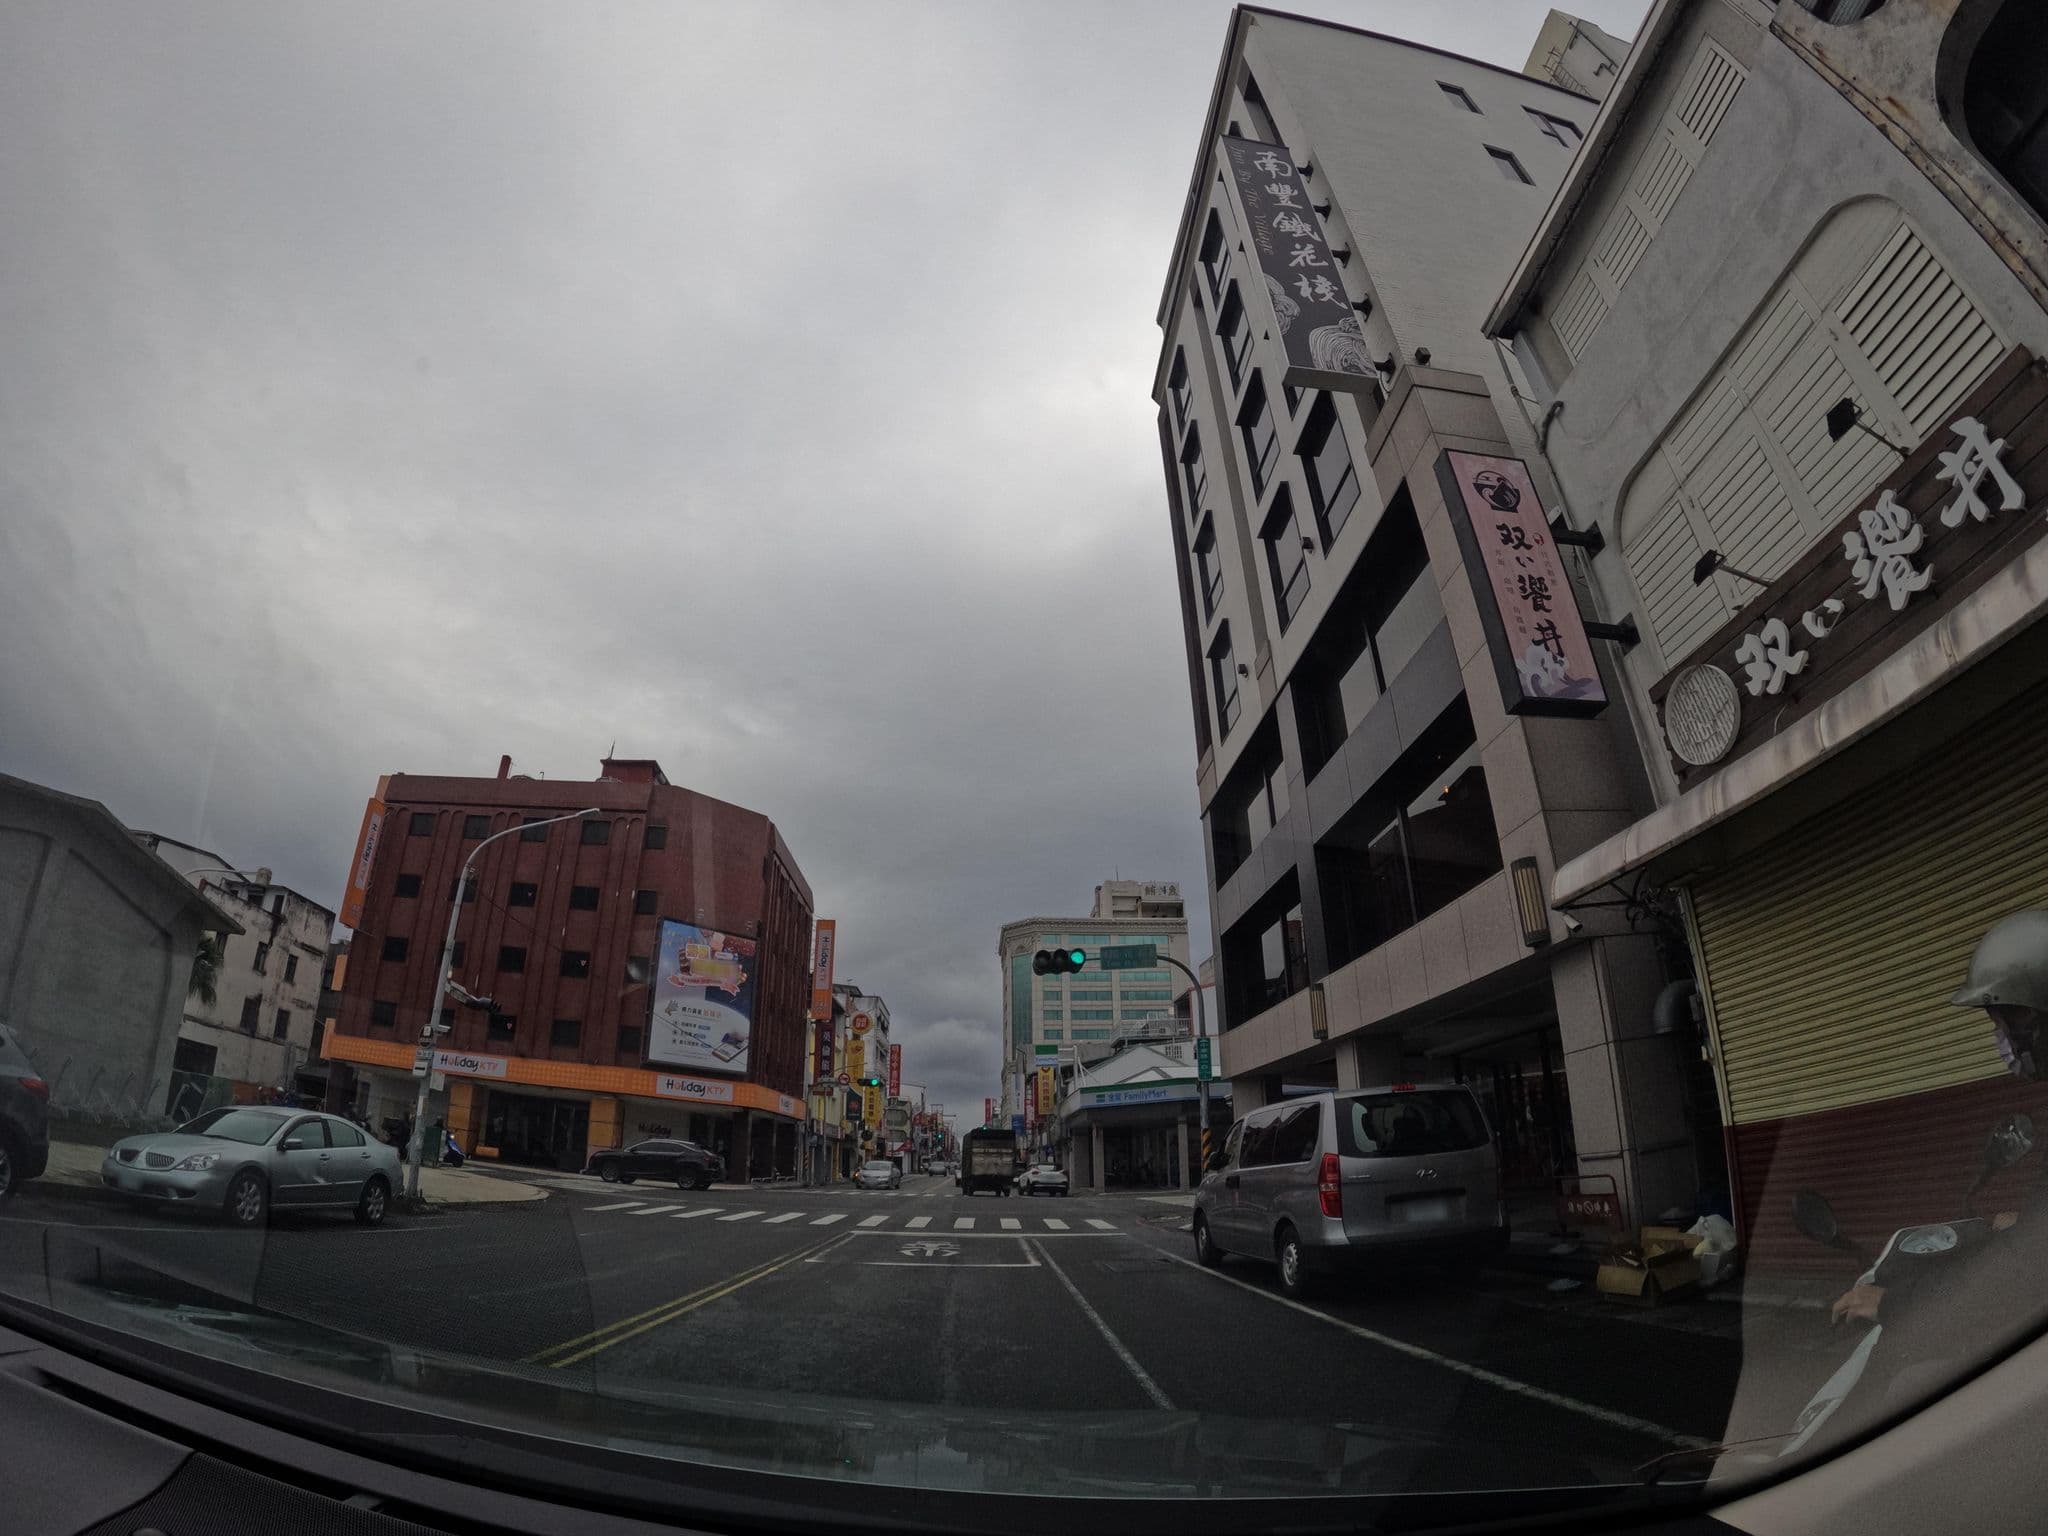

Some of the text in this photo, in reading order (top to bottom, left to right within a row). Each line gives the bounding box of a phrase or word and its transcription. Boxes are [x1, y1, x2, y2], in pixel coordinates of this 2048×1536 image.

[1253, 151, 1348, 310] 南豐鐵花棧
[440, 1054, 479, 1072] Holiday
[666, 1079, 725, 1097] Holiday KTV
[1124, 1088, 1167, 1102] FamilyMart
